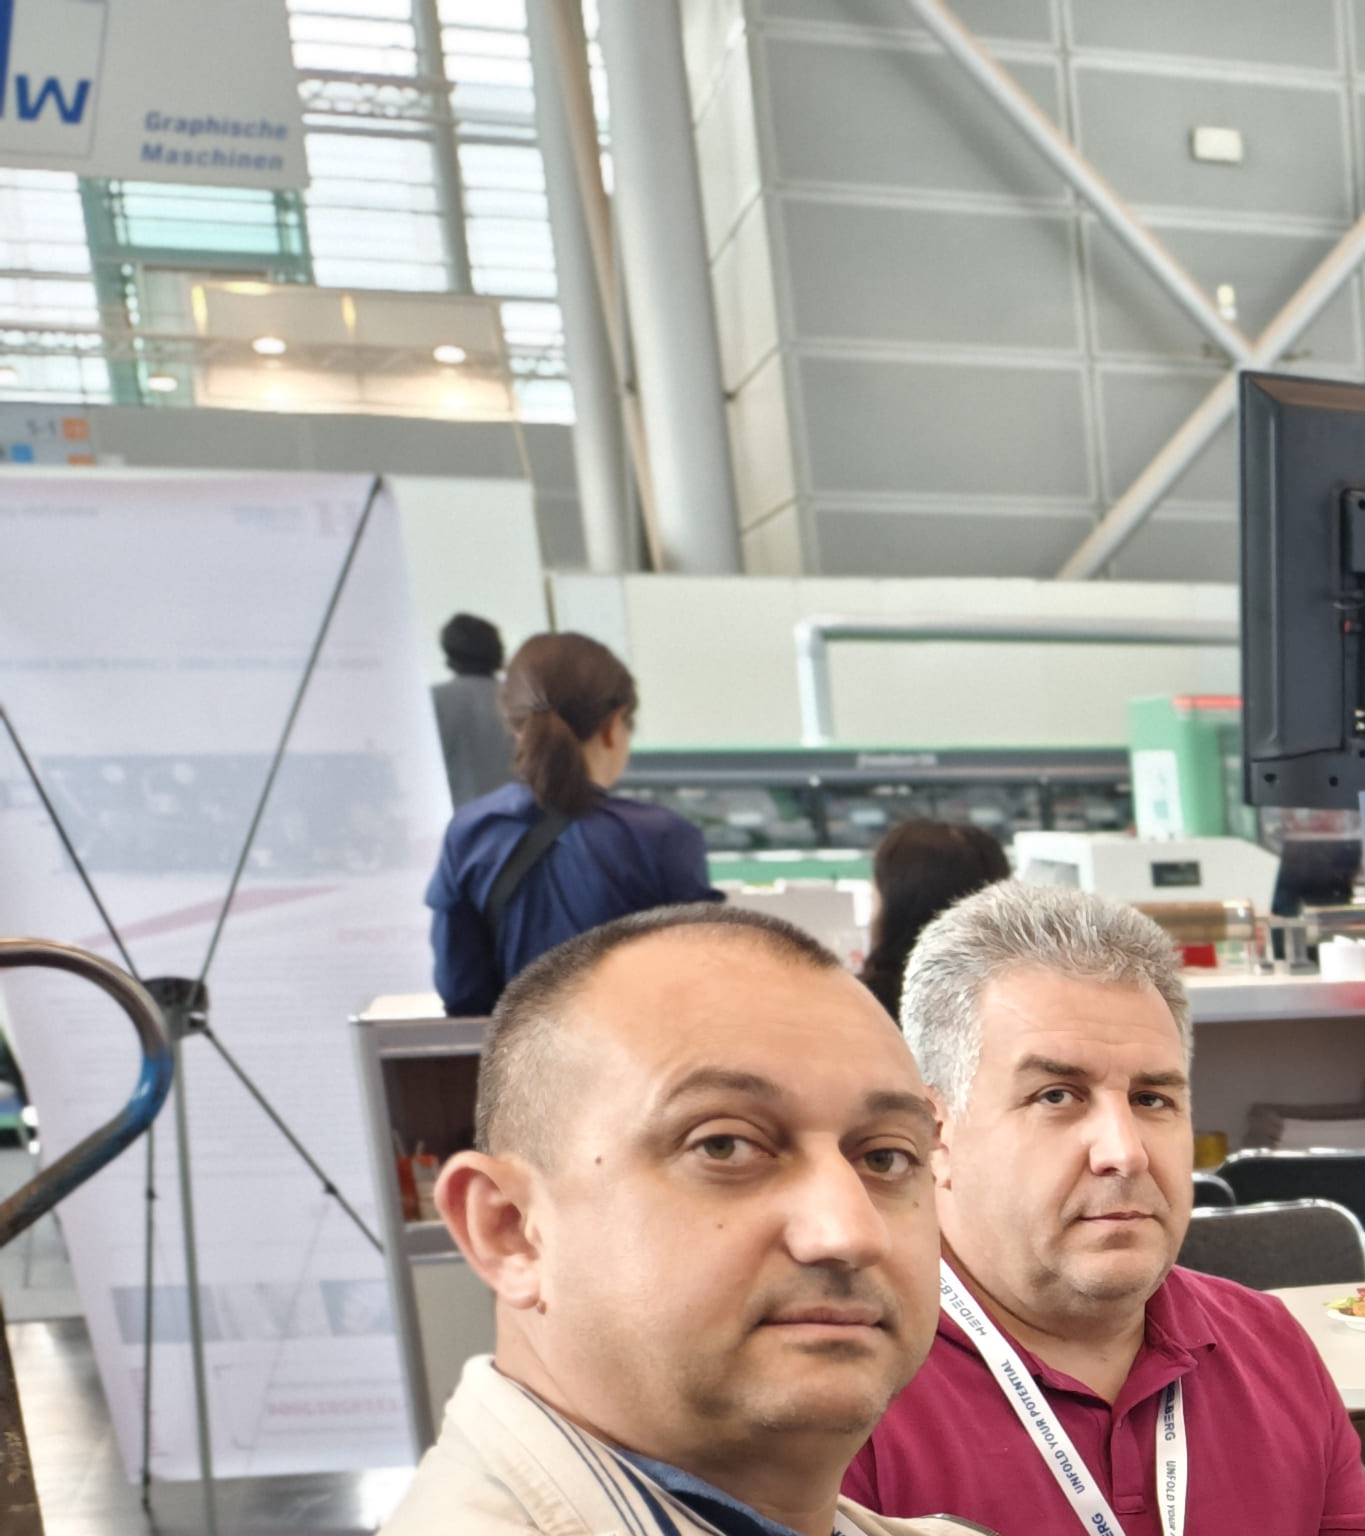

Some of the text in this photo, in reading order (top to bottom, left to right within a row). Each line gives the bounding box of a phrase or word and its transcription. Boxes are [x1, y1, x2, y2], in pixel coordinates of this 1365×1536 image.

[143, 111, 289, 139] Graphische
[140, 143, 284, 170] Maschinen
[1000, 1358, 1044, 1421] POTENTIAL
[1034, 1417, 1060, 1450] YOUR
[1053, 1449, 1087, 1495] UNFOLD
[1165, 1460, 1178, 1501] UNFOLD
